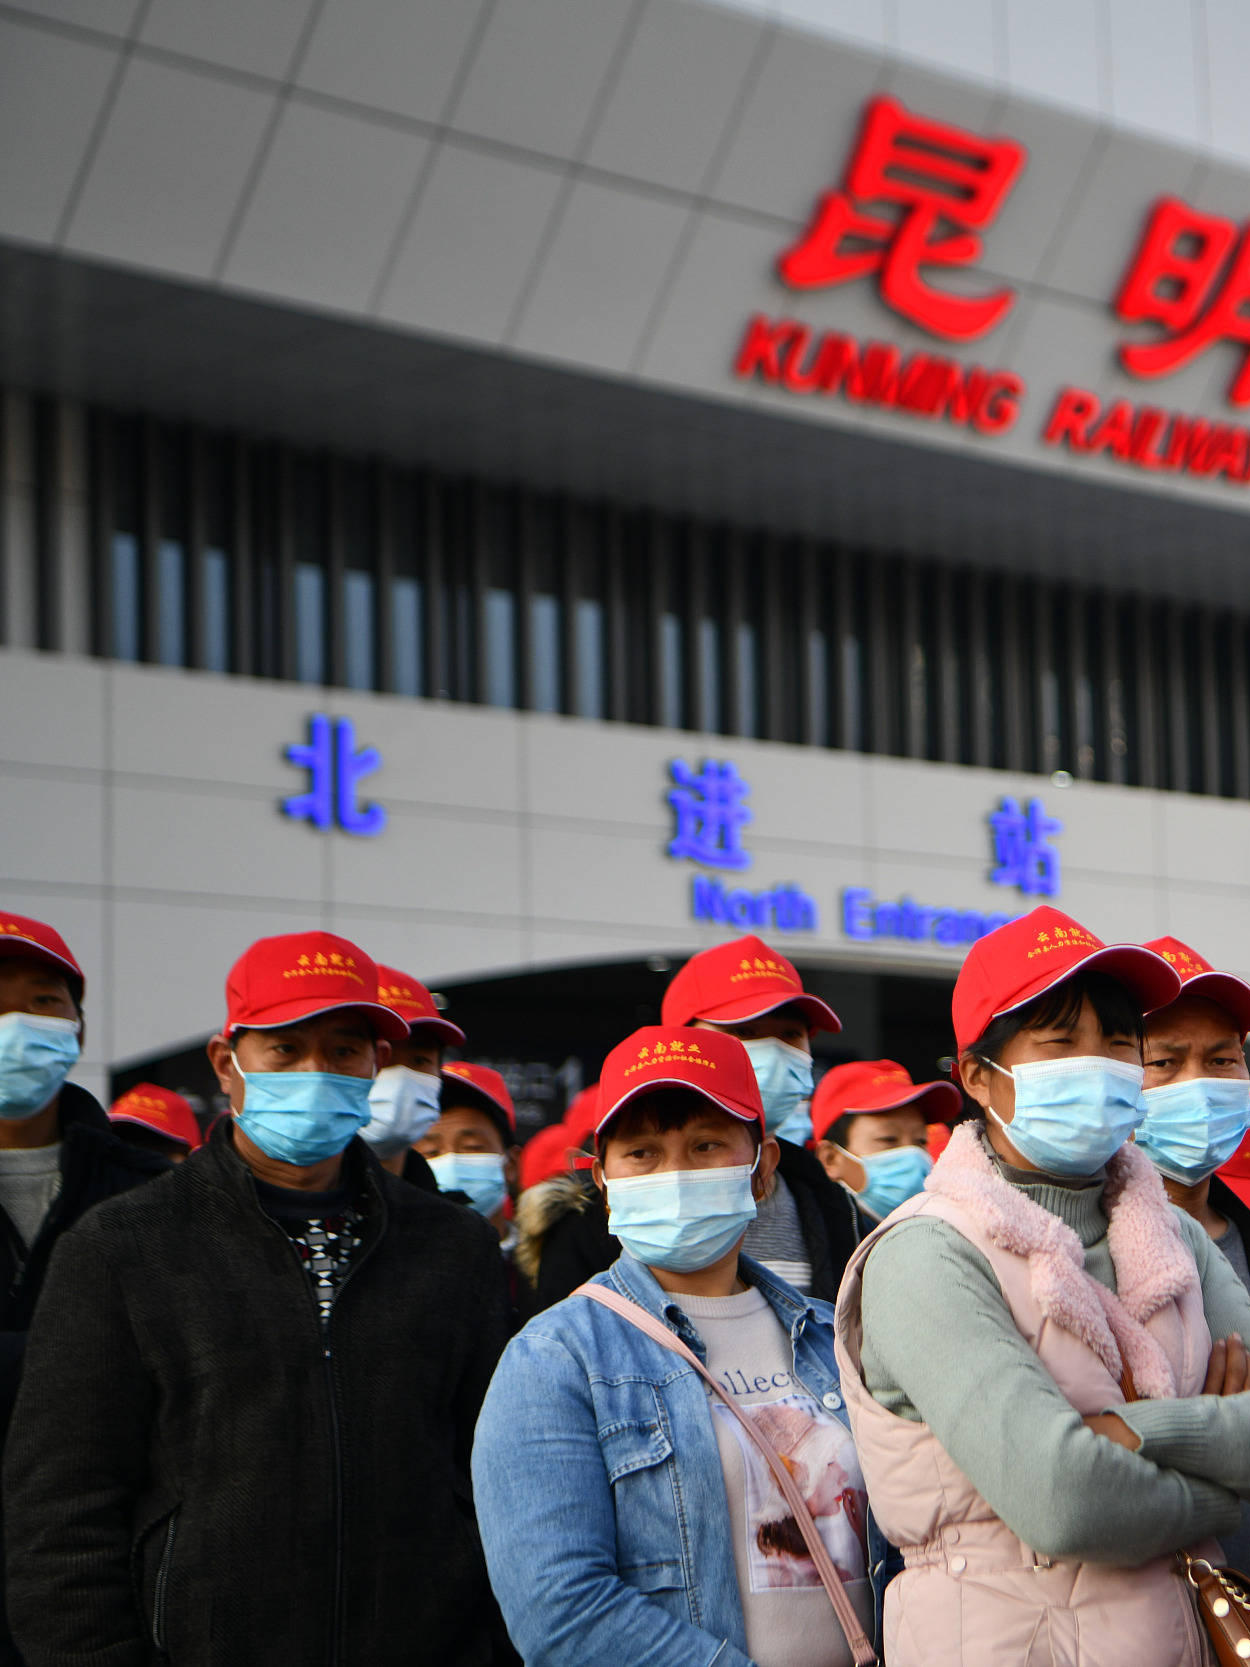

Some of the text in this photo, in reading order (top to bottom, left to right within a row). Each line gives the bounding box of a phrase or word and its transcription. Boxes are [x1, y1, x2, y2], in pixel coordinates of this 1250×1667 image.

[735, 316, 1025, 435] KUNMING
[692, 873, 1028, 948] North Entran
